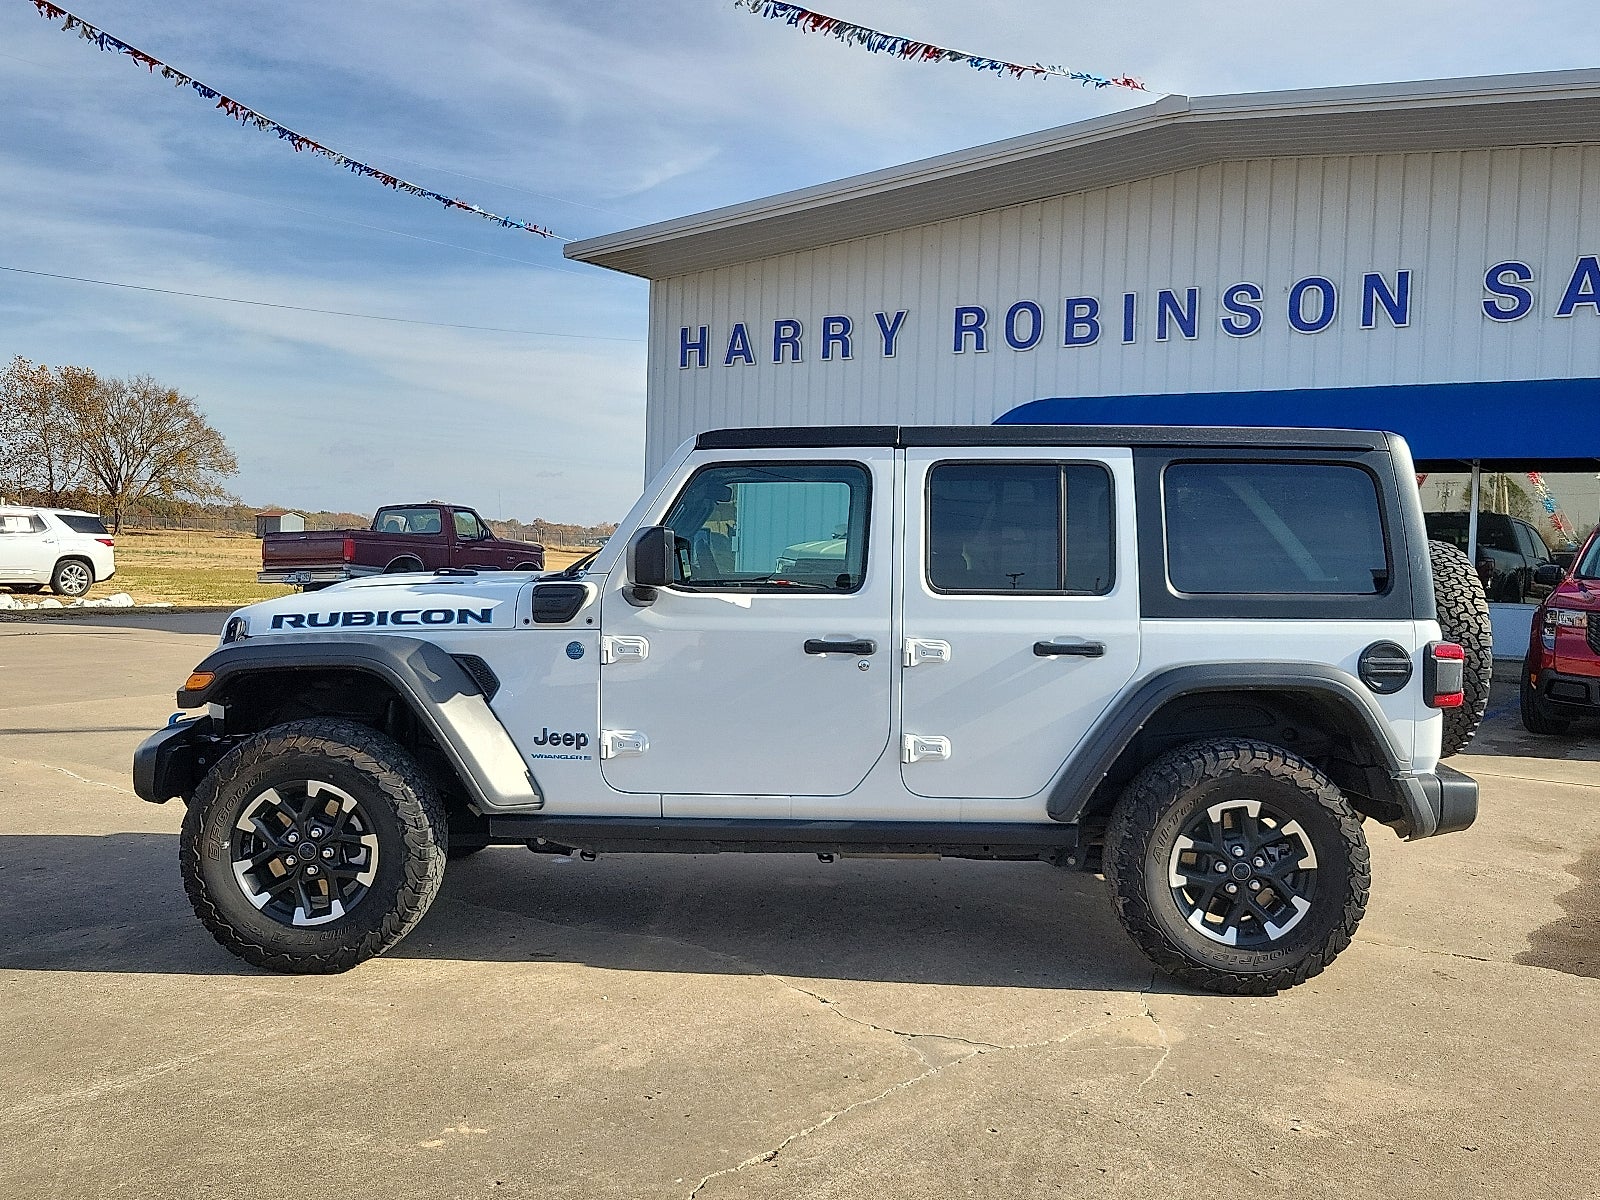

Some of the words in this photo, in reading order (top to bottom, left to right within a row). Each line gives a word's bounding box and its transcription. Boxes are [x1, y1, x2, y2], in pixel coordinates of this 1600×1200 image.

[679, 309, 908, 370] HARRY
[952, 269, 1413, 354] ROBINSON
[1481, 254, 1600, 323] SA
[270, 608, 494, 630] RUBICON
[533, 727, 589, 751] Jeep
